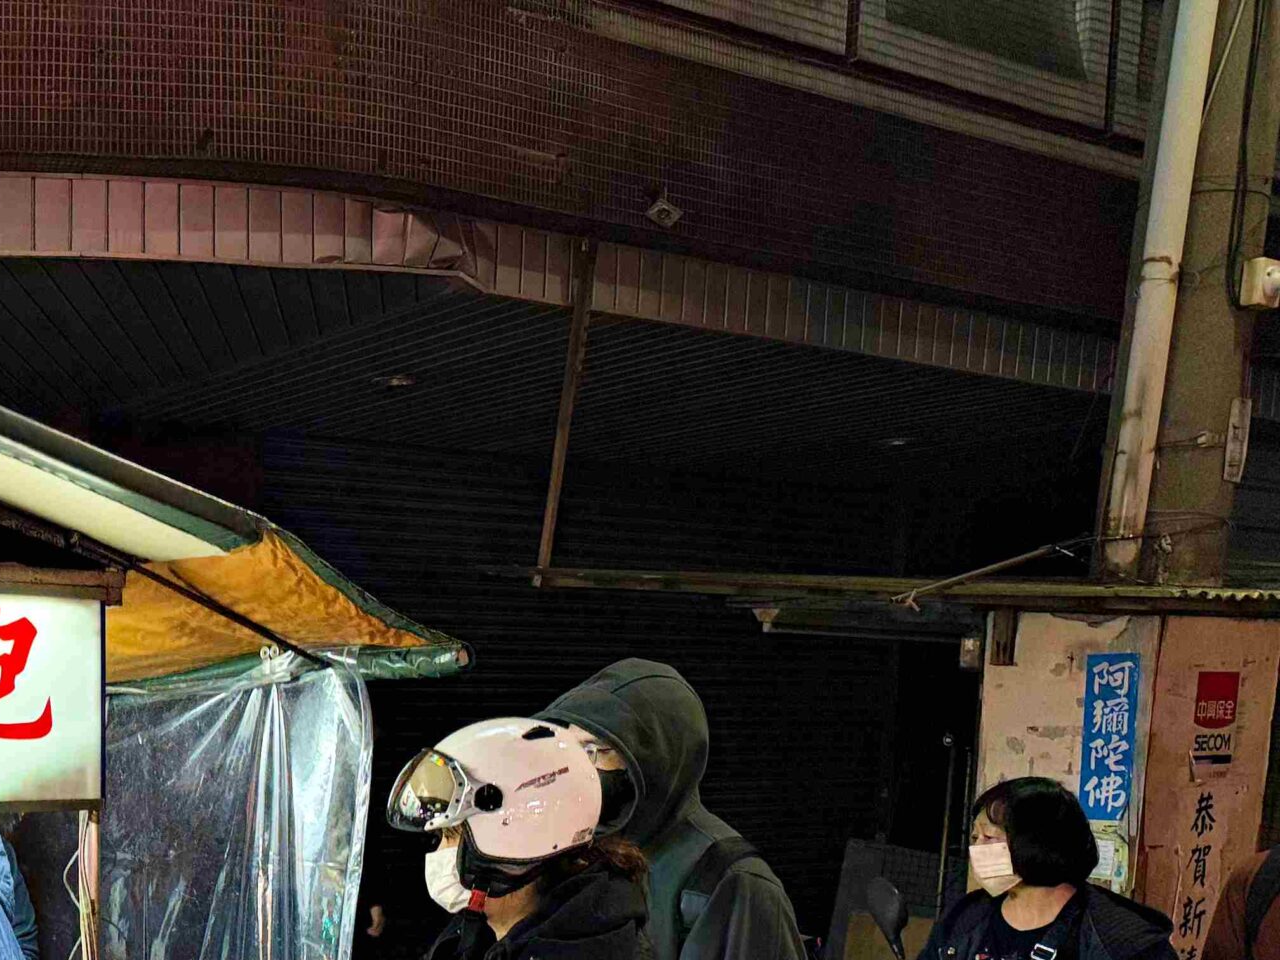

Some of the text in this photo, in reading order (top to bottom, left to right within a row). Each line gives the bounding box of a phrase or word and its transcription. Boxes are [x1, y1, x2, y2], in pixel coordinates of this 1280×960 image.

[1083, 660, 1134, 820] 阿彌陀佛
[1193, 733, 1231, 753] SECOM
